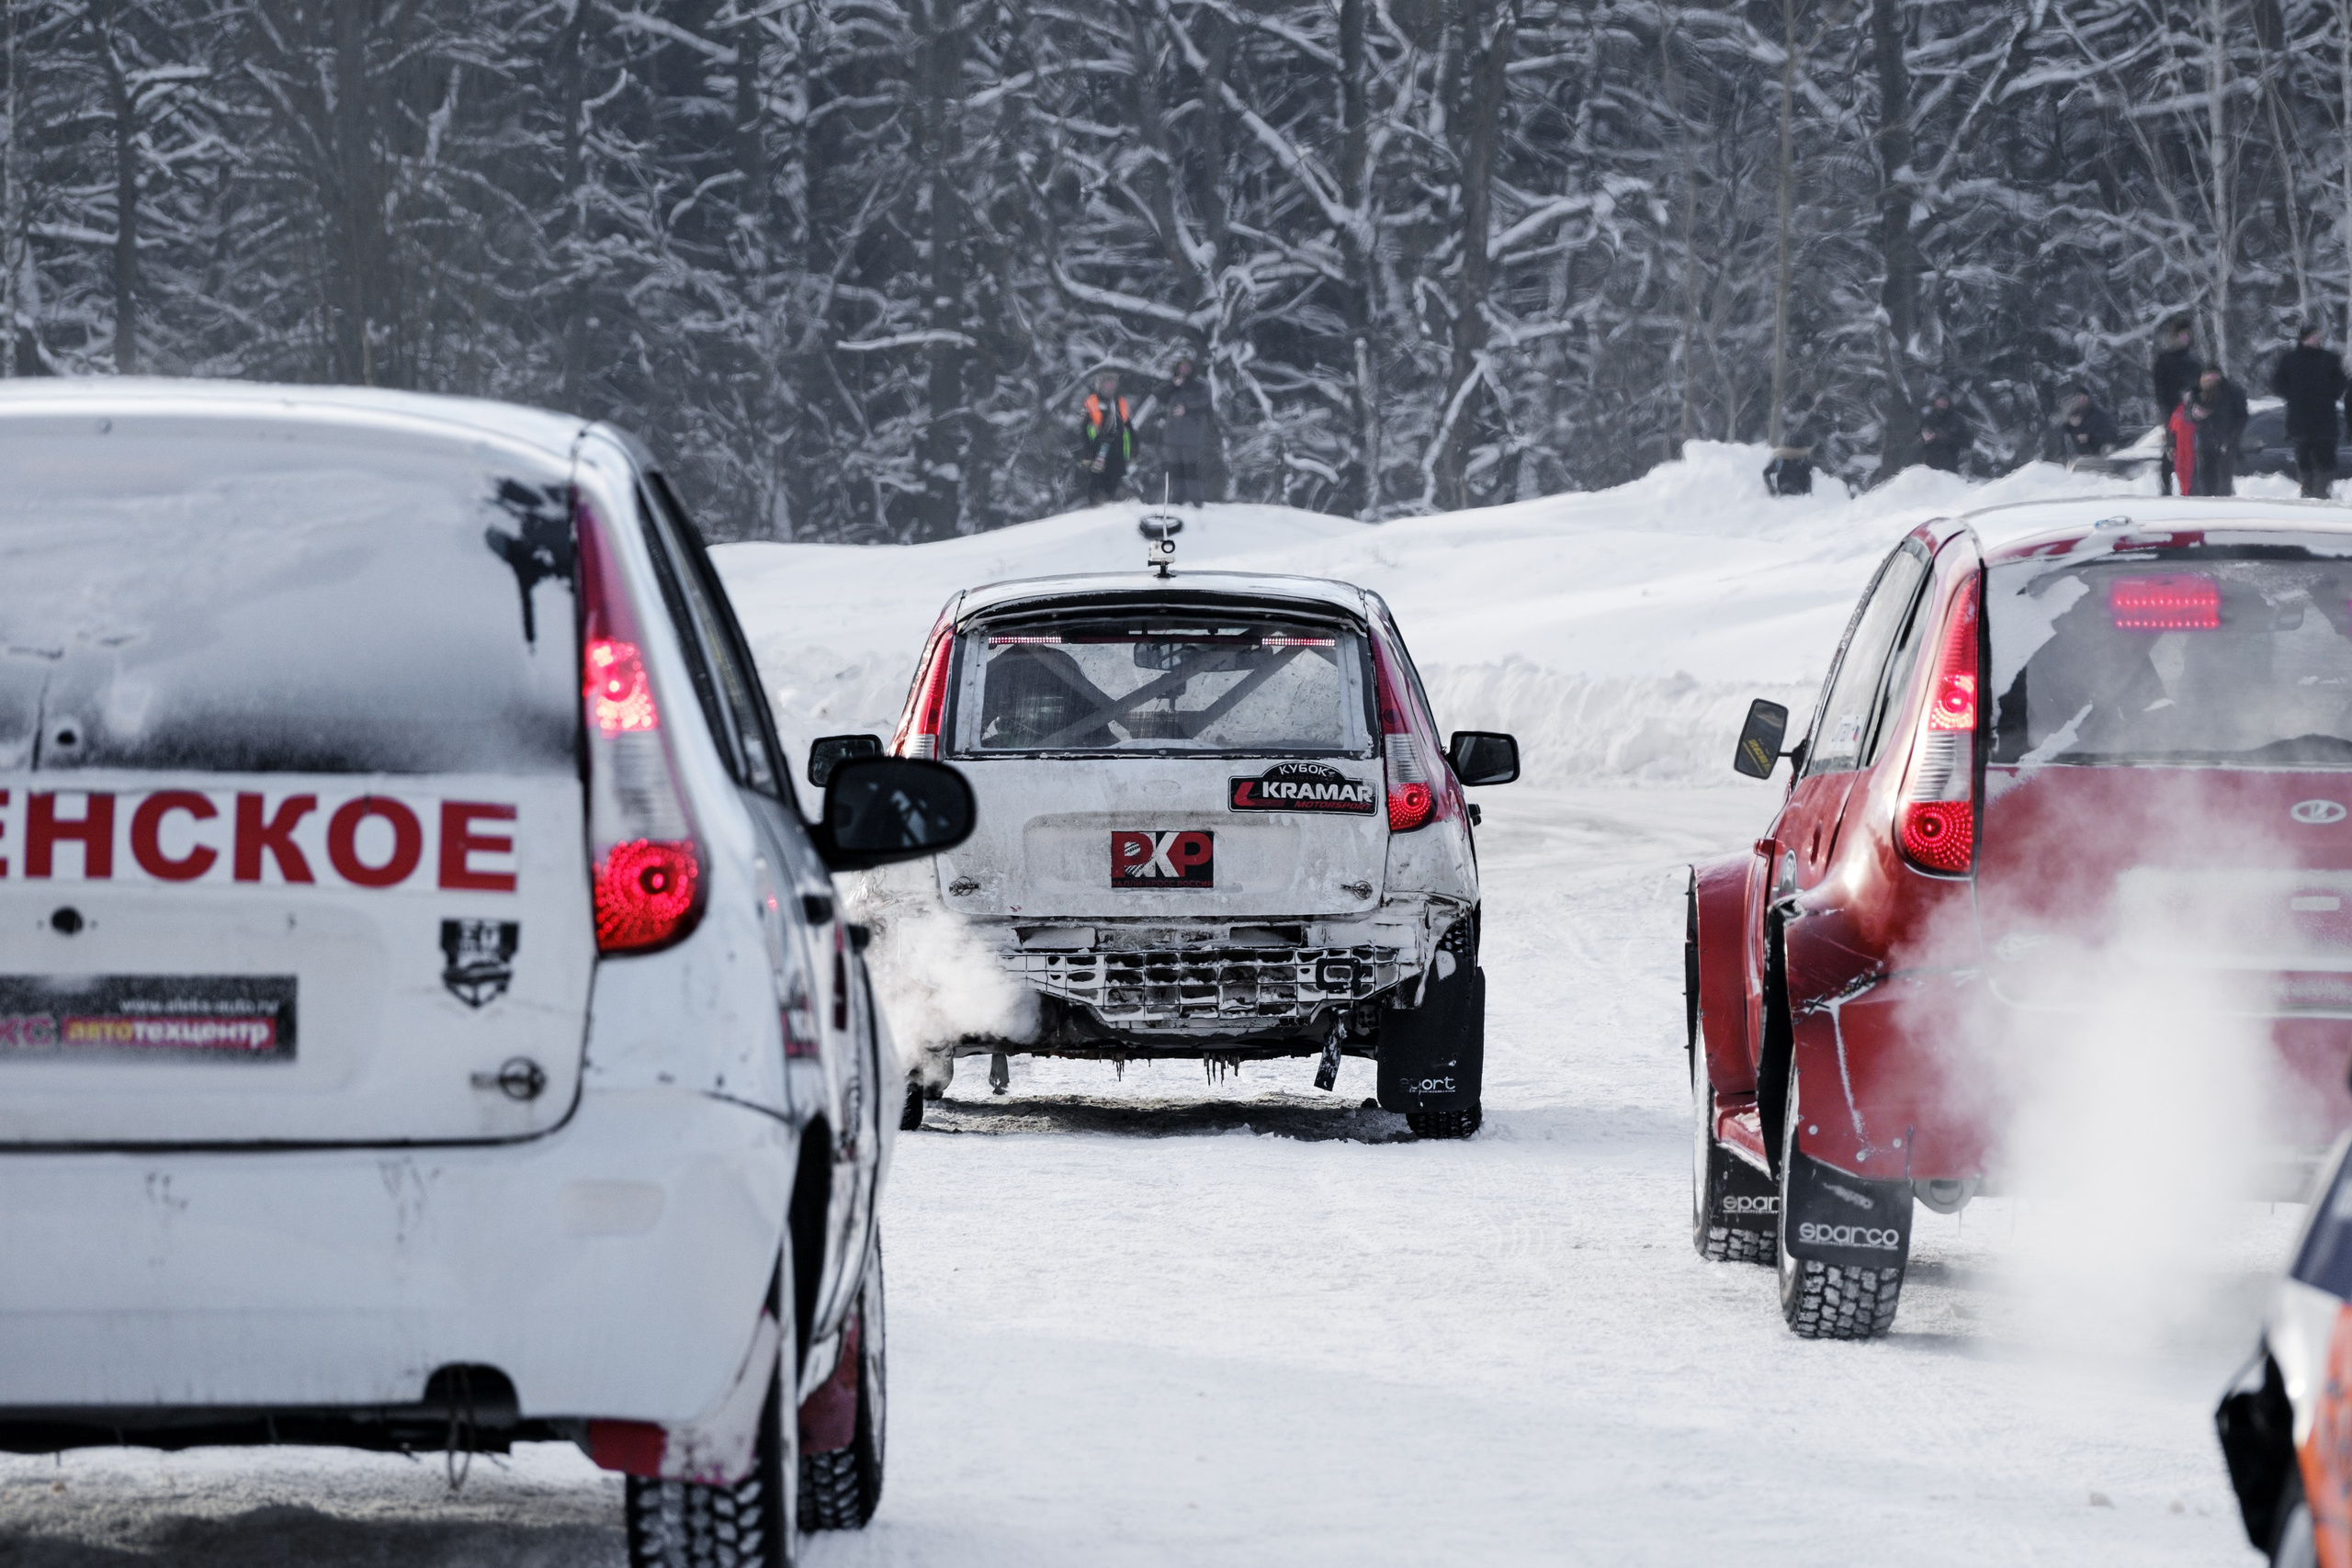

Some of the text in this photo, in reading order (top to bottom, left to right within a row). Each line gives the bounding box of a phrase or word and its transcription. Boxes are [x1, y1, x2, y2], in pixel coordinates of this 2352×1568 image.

[1279, 763, 1327, 777] КУБОК
[1262, 782, 1373, 803] KRAMAR
[1294, 800, 1373, 810] MOTORSPORT
[0, 789, 516, 892] НСКОЕ
[1799, 1222, 1900, 1246] sparco
